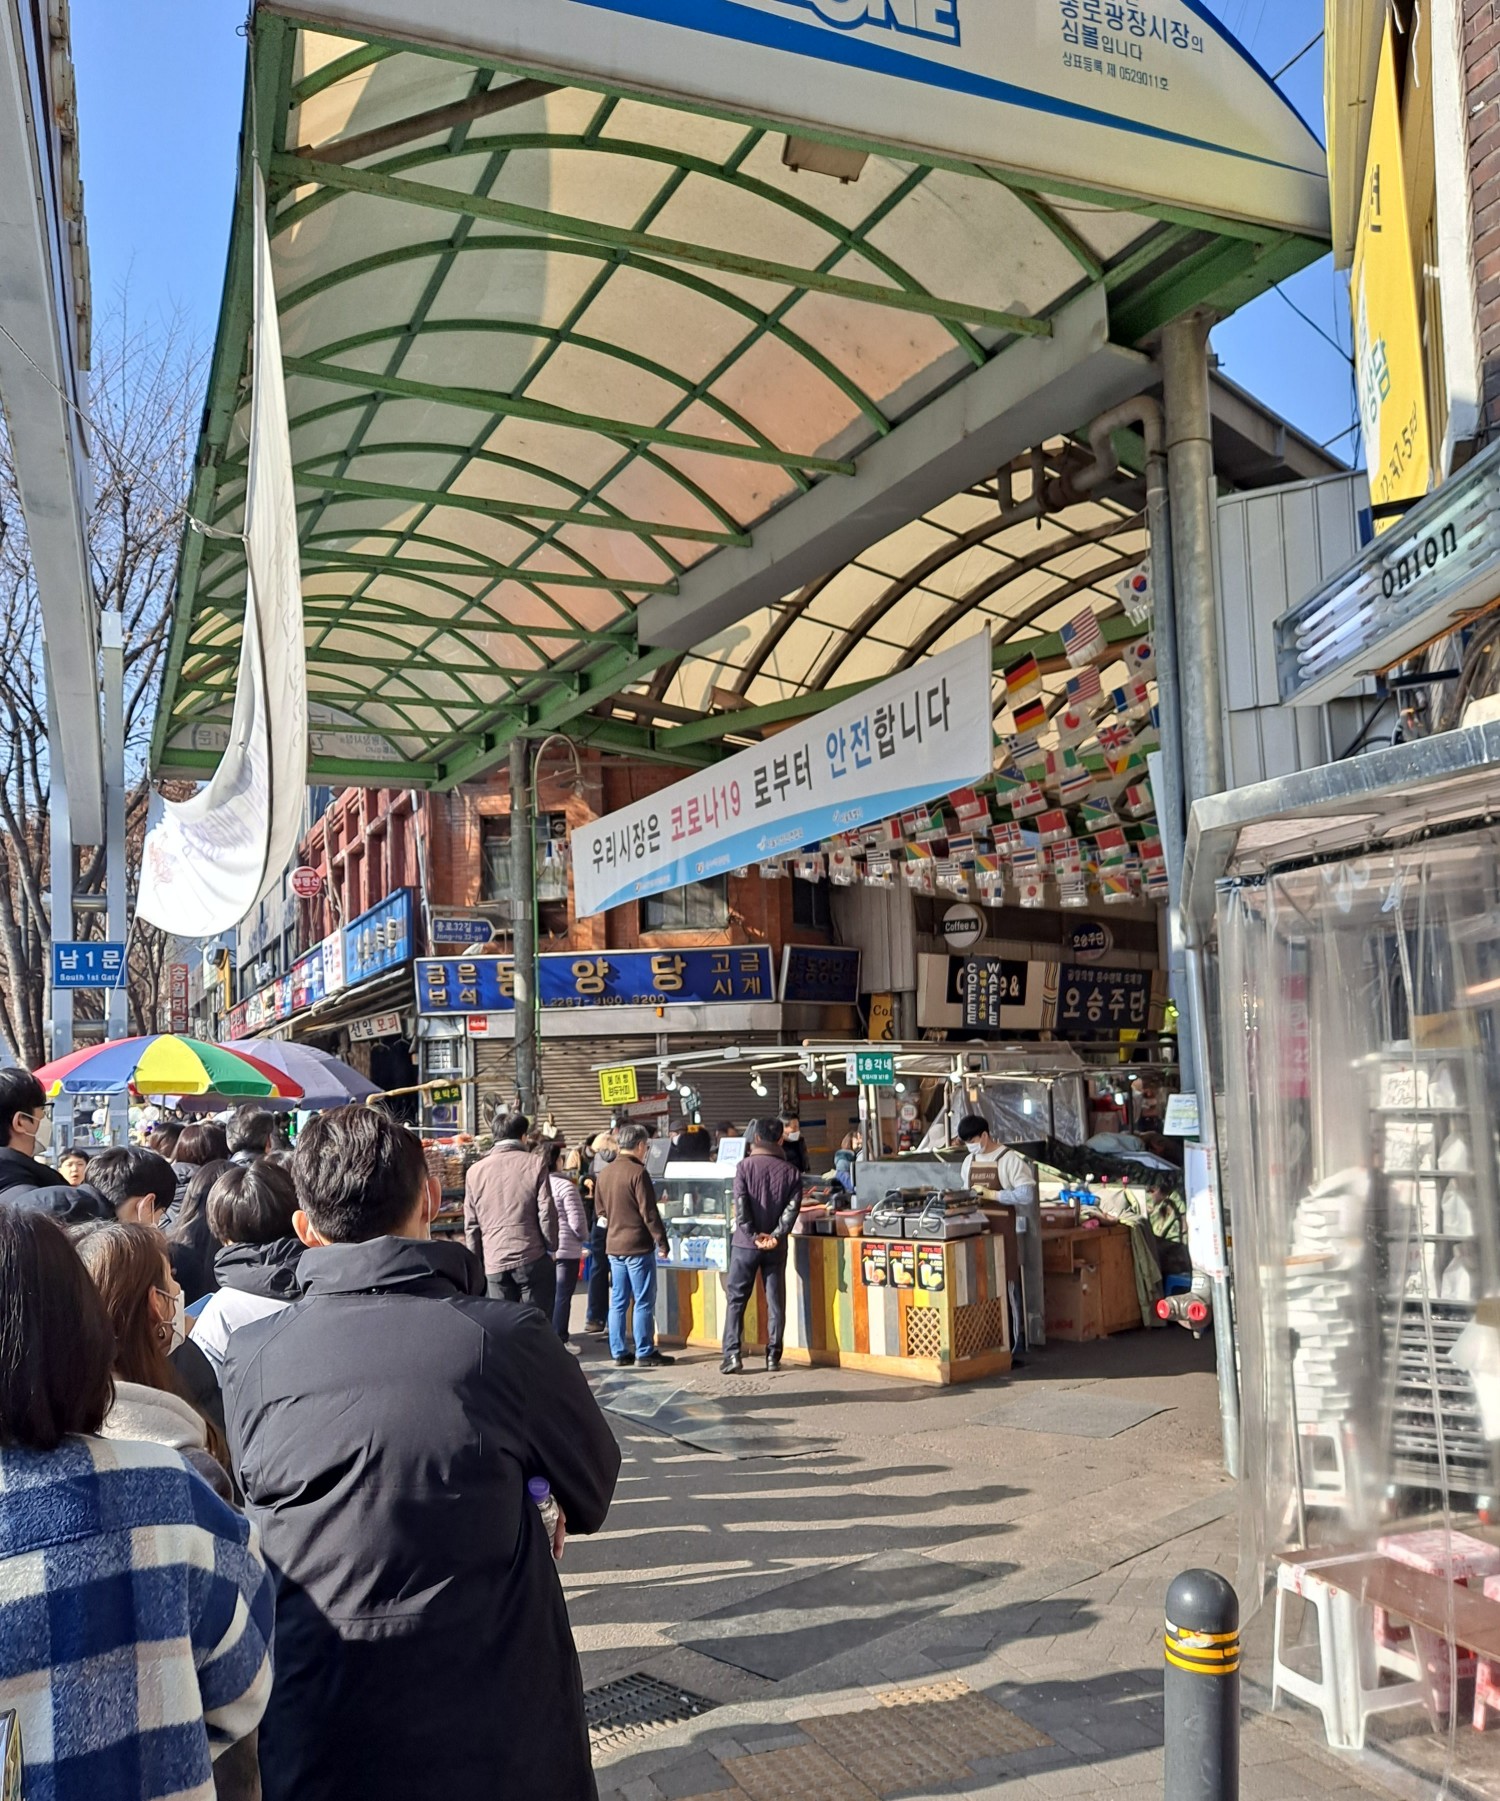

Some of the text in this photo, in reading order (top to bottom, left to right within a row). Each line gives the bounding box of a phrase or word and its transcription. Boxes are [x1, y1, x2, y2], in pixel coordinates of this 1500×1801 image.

[1061, 19, 1143, 61] 심볼입니다
[1062, 51, 1103, 75] 상표등록
[1382, 522, 1457, 599] onion
[592, 677, 950, 874] 우리시장은 코로나19 로부터 안전합니다
[945, 920, 977, 932] Coffee &
[1073, 932, 1105, 948] 오승주단
[60, 973, 85, 981] South
[86, 973, 99, 981] 1st
[966, 963, 977, 1024] COFFEE
[986, 962, 1000, 1025] WAFFLE
[1062, 986, 1145, 1023] 오승주단
